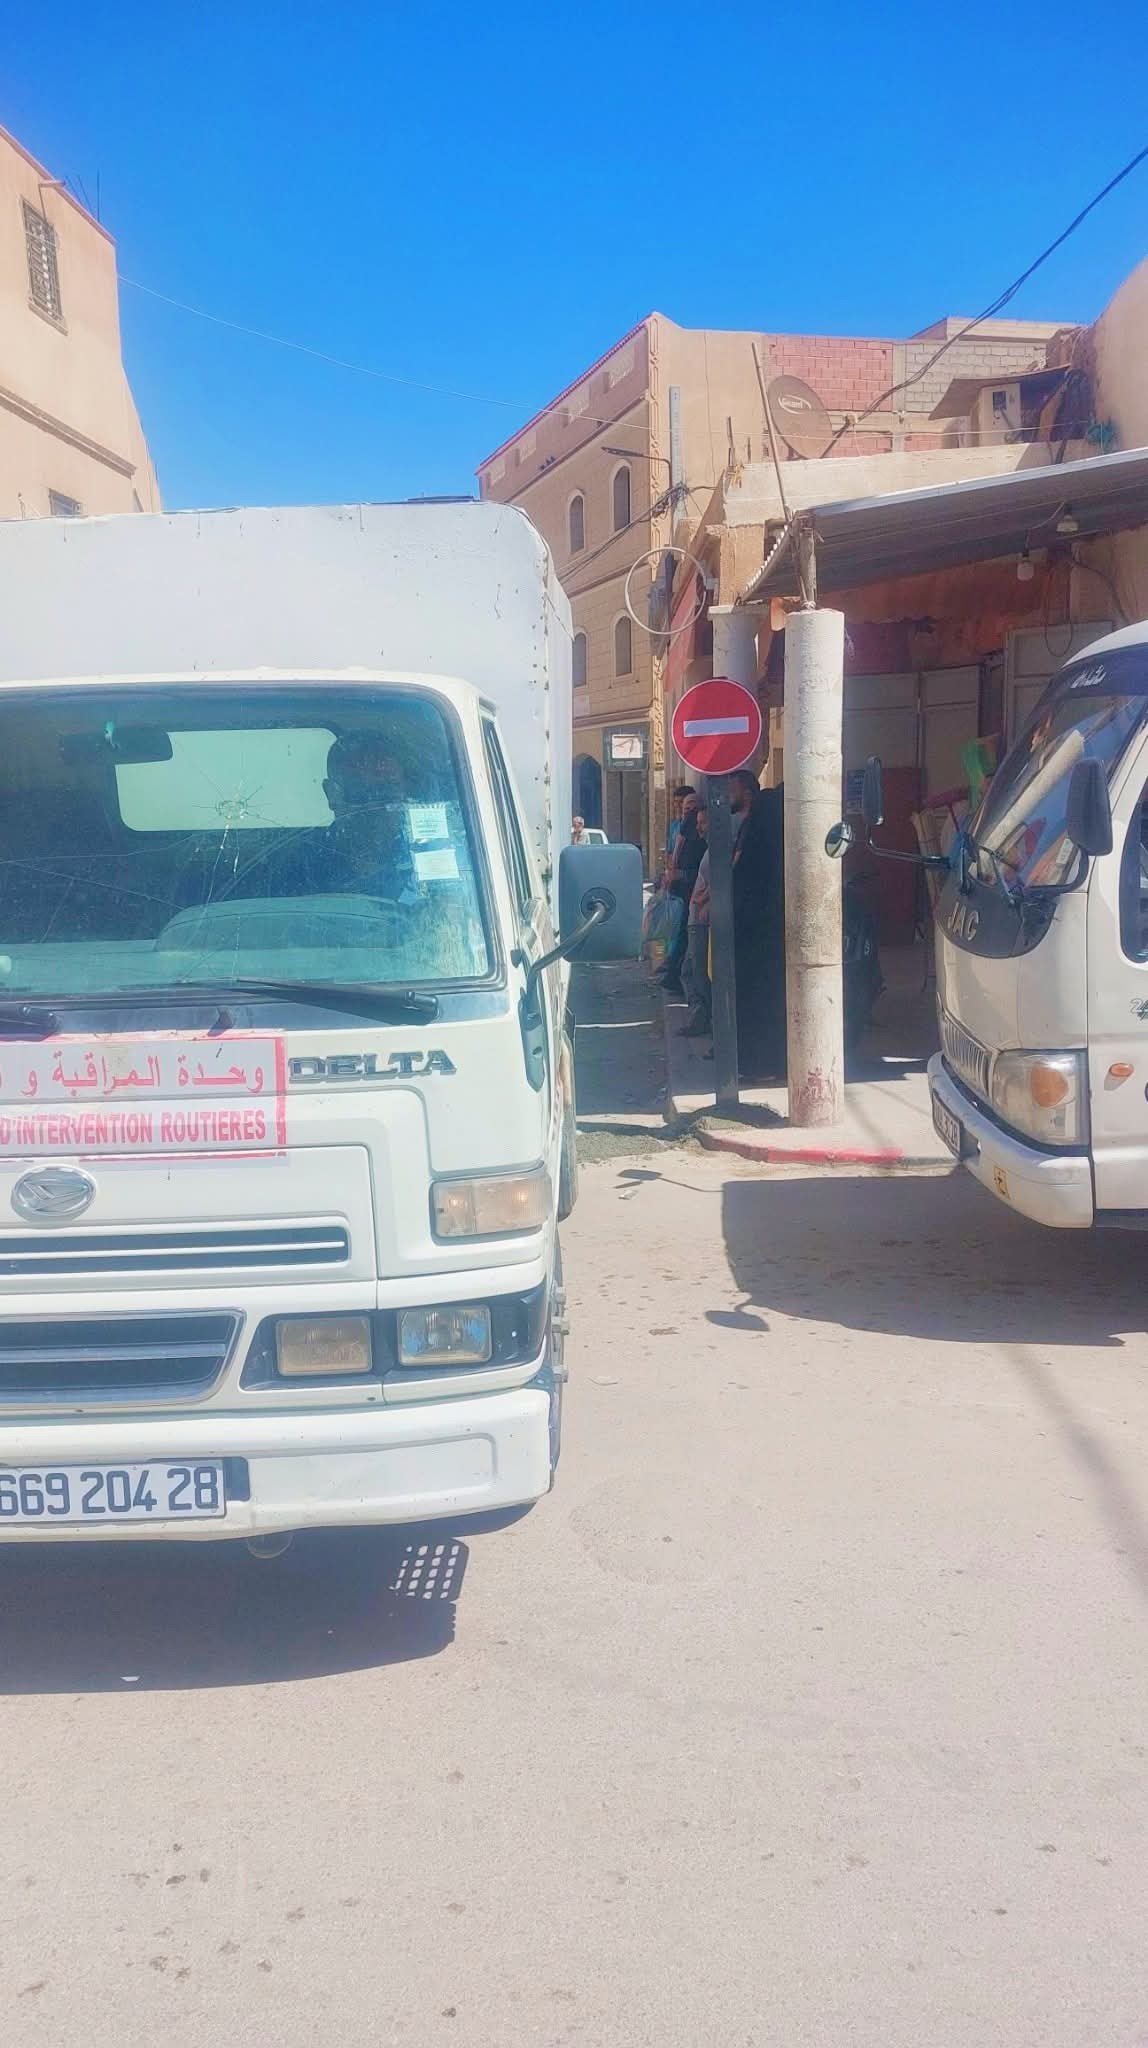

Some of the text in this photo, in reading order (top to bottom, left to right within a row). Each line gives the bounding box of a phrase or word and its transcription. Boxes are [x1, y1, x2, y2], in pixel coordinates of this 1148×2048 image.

[946, 901, 979, 941] JAC
[20, 1050, 263, 1096] وحدة المراقبة و
[288, 1049, 457, 1084] DELTA
[0, 1110, 266, 1145] D'INTERVENTION ROUTIERES
[0, 1466, 219, 1516] 669 204 28
